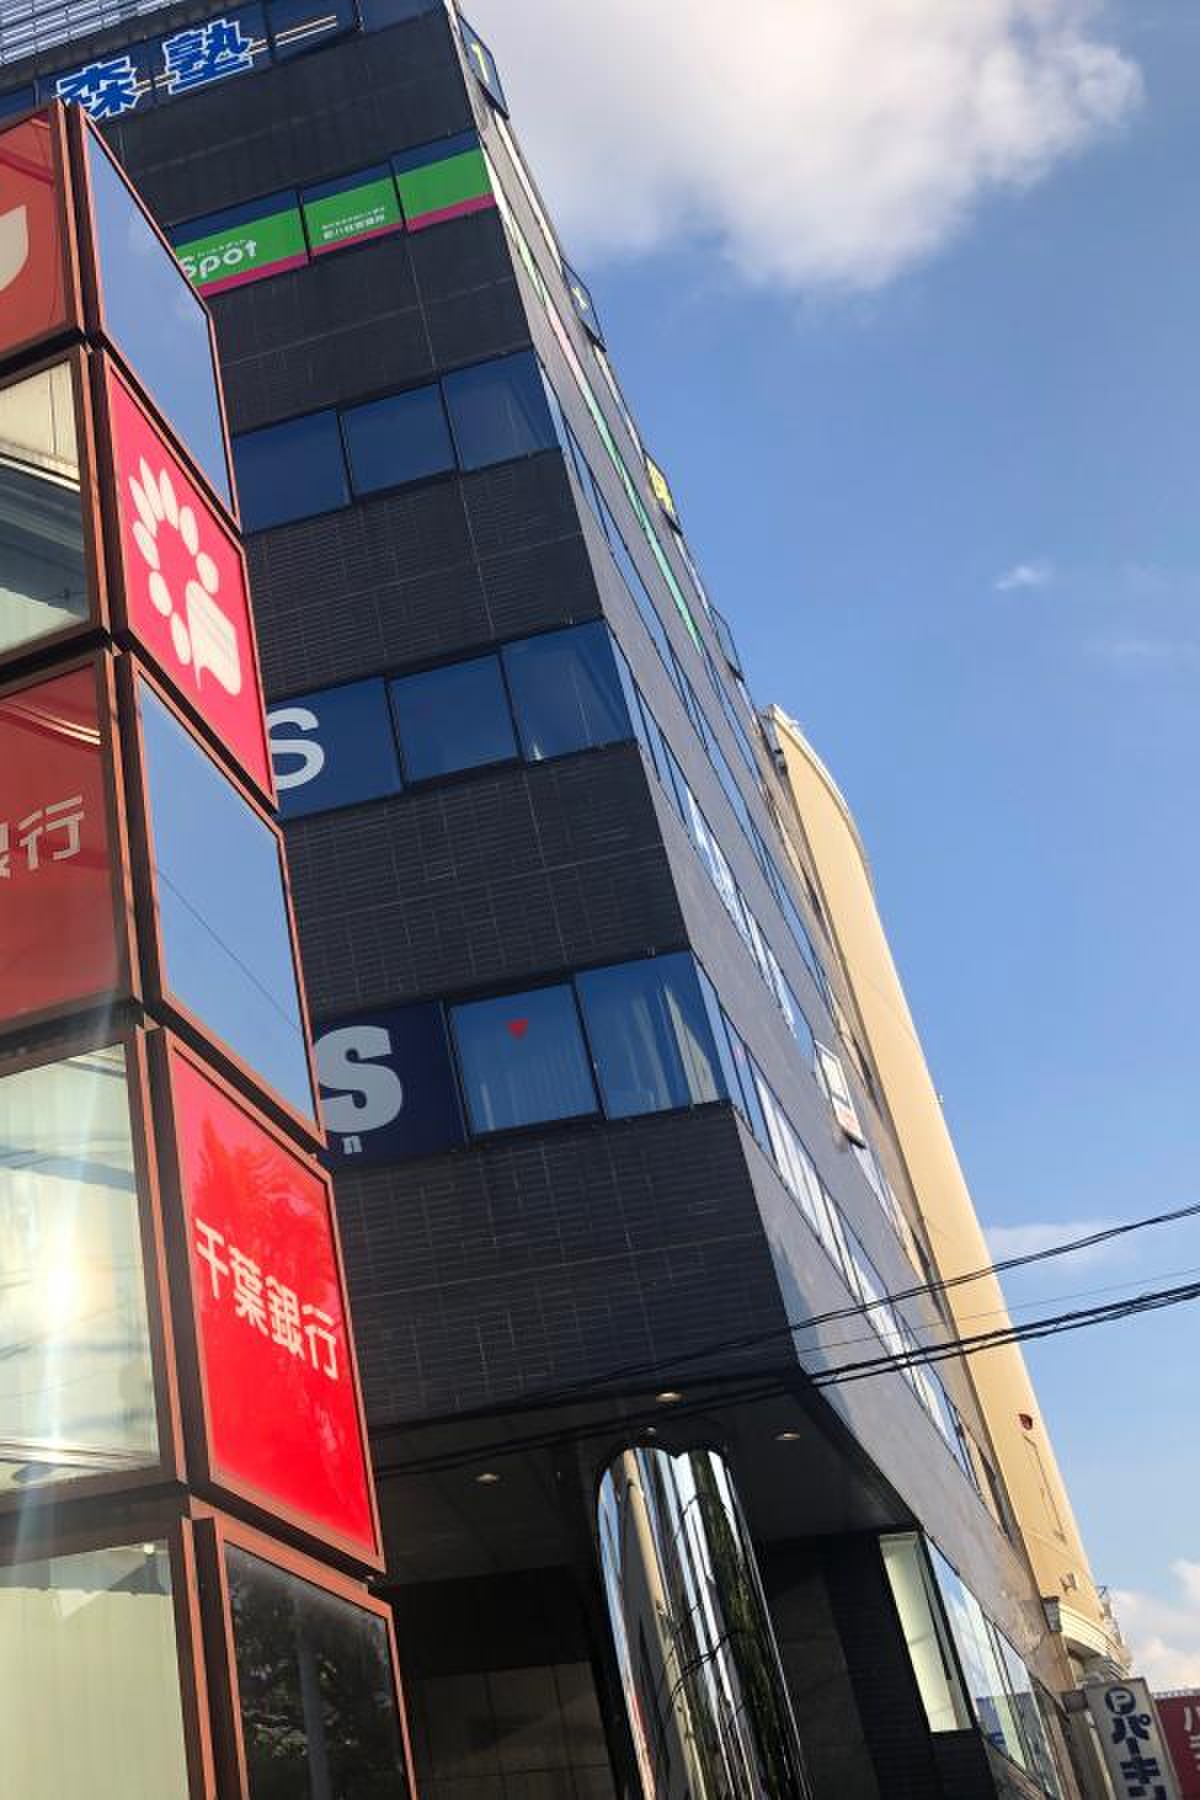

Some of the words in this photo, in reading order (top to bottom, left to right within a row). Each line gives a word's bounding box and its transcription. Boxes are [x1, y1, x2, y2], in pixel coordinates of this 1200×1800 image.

[56, 18, 255, 121] 森塾
[314, 1024, 403, 1134] S
[195, 1217, 338, 1379] 千葉銀行
